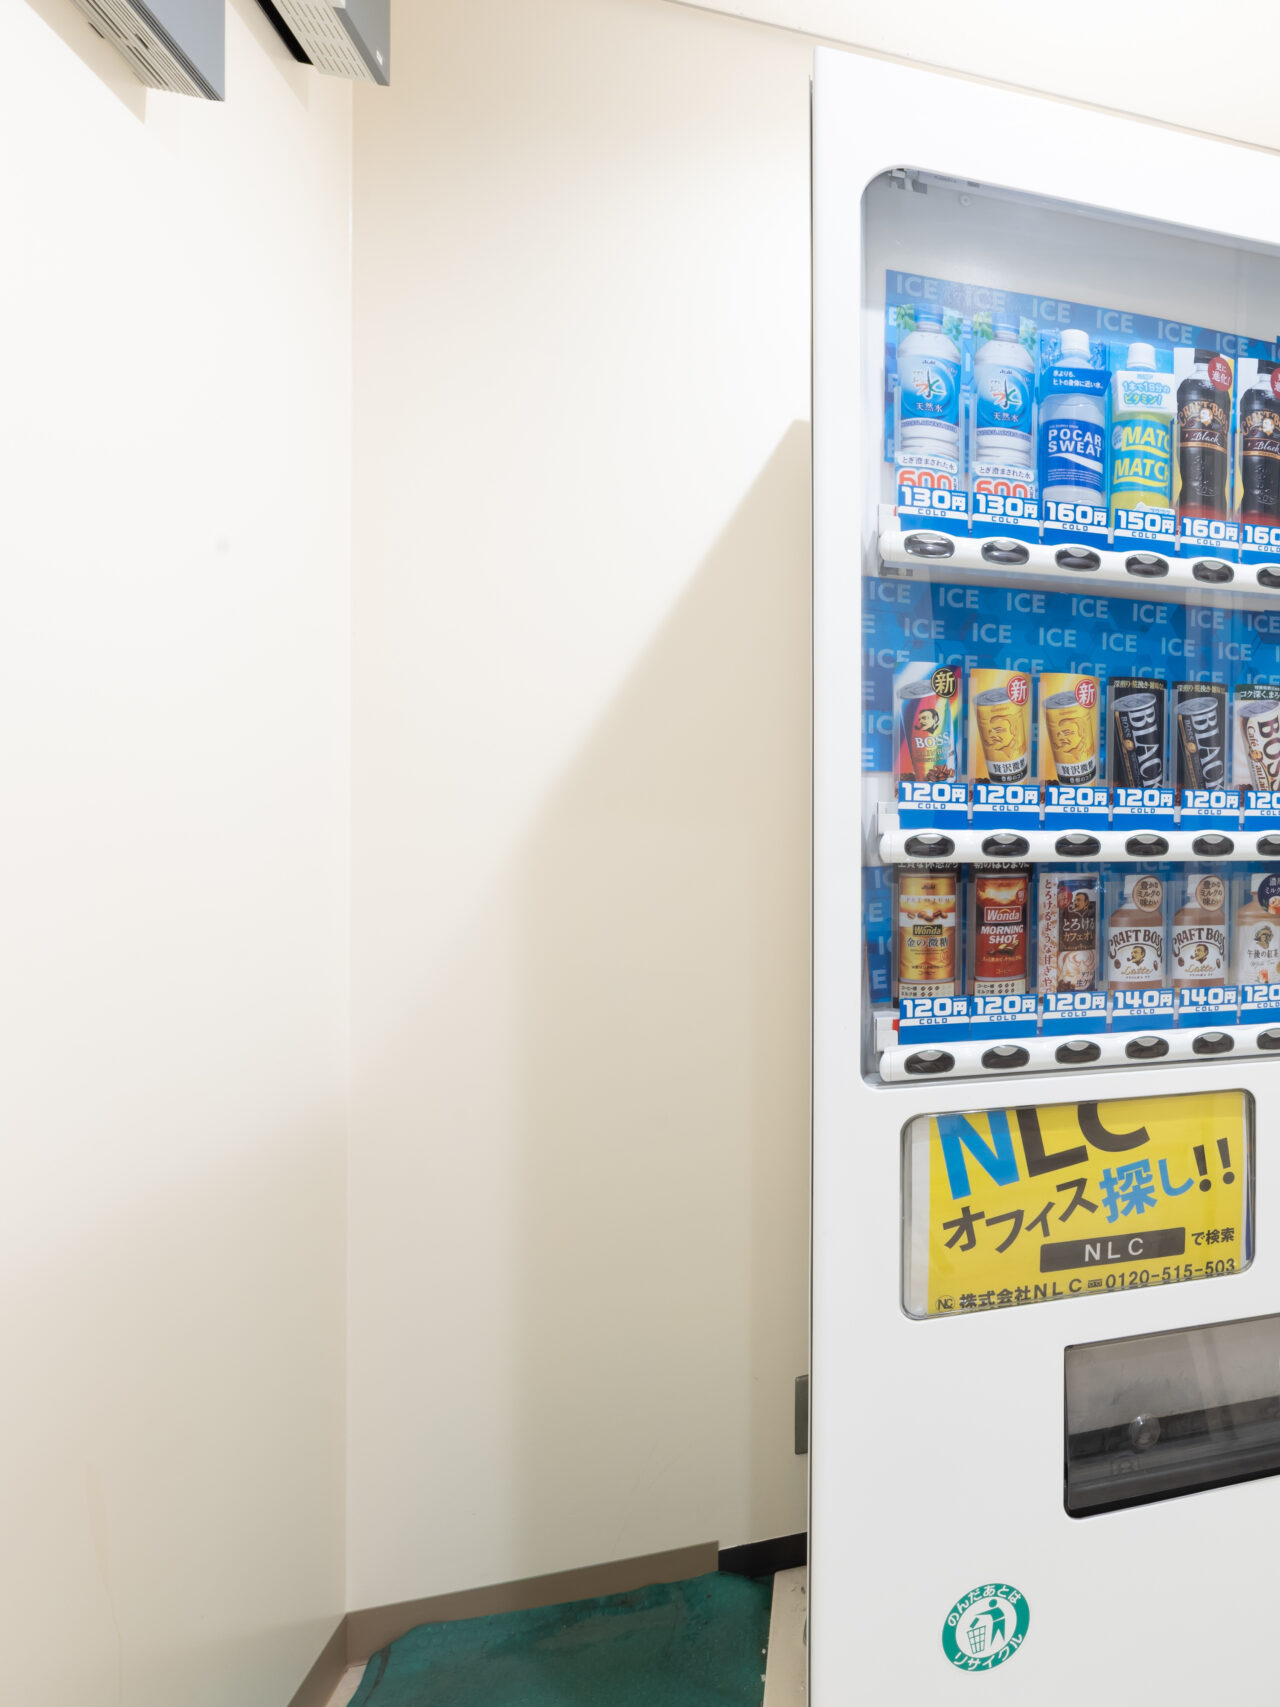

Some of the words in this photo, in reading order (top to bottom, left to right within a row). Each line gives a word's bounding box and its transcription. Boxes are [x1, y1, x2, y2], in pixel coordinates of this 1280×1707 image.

[1032, 298, 1071, 324] ICE
[1096, 310, 1134, 335] ICE
[1158, 320, 1193, 345] ICE
[916, 402, 943, 413] 天然水
[993, 412, 1019, 423] 天然水
[1048, 429, 1102, 446] POCAR
[1122, 426, 1169, 447] MATC
[1191, 431, 1220, 446] Black
[1048, 441, 1102, 458] SWEAT
[1253, 441, 1280, 454] Black
[902, 486, 966, 511] 130円
[976, 494, 1038, 518] 130円
[918, 508, 947, 517] COLD
[991, 516, 1019, 525] COLD
[1047, 502, 1107, 525] 160円
[1118, 511, 1174, 533] 150円
[1062, 523, 1088, 532] COLD
[1131, 531, 1157, 539] COLD
[1182, 518, 1238, 540] 160円
[939, 588, 979, 609] ICE
[1007, 592, 1046, 614] ICE
[972, 622, 1012, 644] ICE
[1039, 627, 1077, 648] ICE
[1102, 632, 1137, 653] ICE
[934, 670, 956, 695] 新
[1010, 679, 1027, 702] 新
[1078, 682, 1095, 705] 新
[915, 731, 950, 749] BOSS
[1127, 706, 1163, 789] BLACK
[902, 783, 966, 802] 120円
[976, 786, 1038, 804] 120円
[1048, 788, 1108, 806] 120円
[1116, 790, 1173, 808] 120円
[1184, 791, 1239, 809] 120円
[987, 908, 1020, 921] Wonda
[914, 925, 941, 935] Wonda
[981, 925, 1024, 934] MORNING
[989, 934, 1018, 944] SHOT
[906, 937, 948, 948] 金の微糖
[1108, 929, 1142, 960] CRAFT
[1173, 927, 1204, 958] CRAFT
[1247, 949, 1279, 959] 午後の紅茶
[974, 996, 1037, 1015] 120円
[1046, 993, 1105, 1011] 120円
[1115, 990, 1173, 1009] 140円
[1181, 987, 1237, 1006] 140円
[903, 999, 967, 1017] 120円
[919, 1017, 948, 1025] COLD
[989, 1014, 1017, 1022] COLD
[936, 1101, 1150, 1200] NLC
[942, 1137, 1236, 1254] オフィス探し!!
[1191, 1227, 1235, 1247] で検索
[1106, 1257, 1236, 1290] 0120-515-503
[947, 1584, 1021, 1627] のんだあとは
[953, 1633, 1023, 1671] リサイクル
